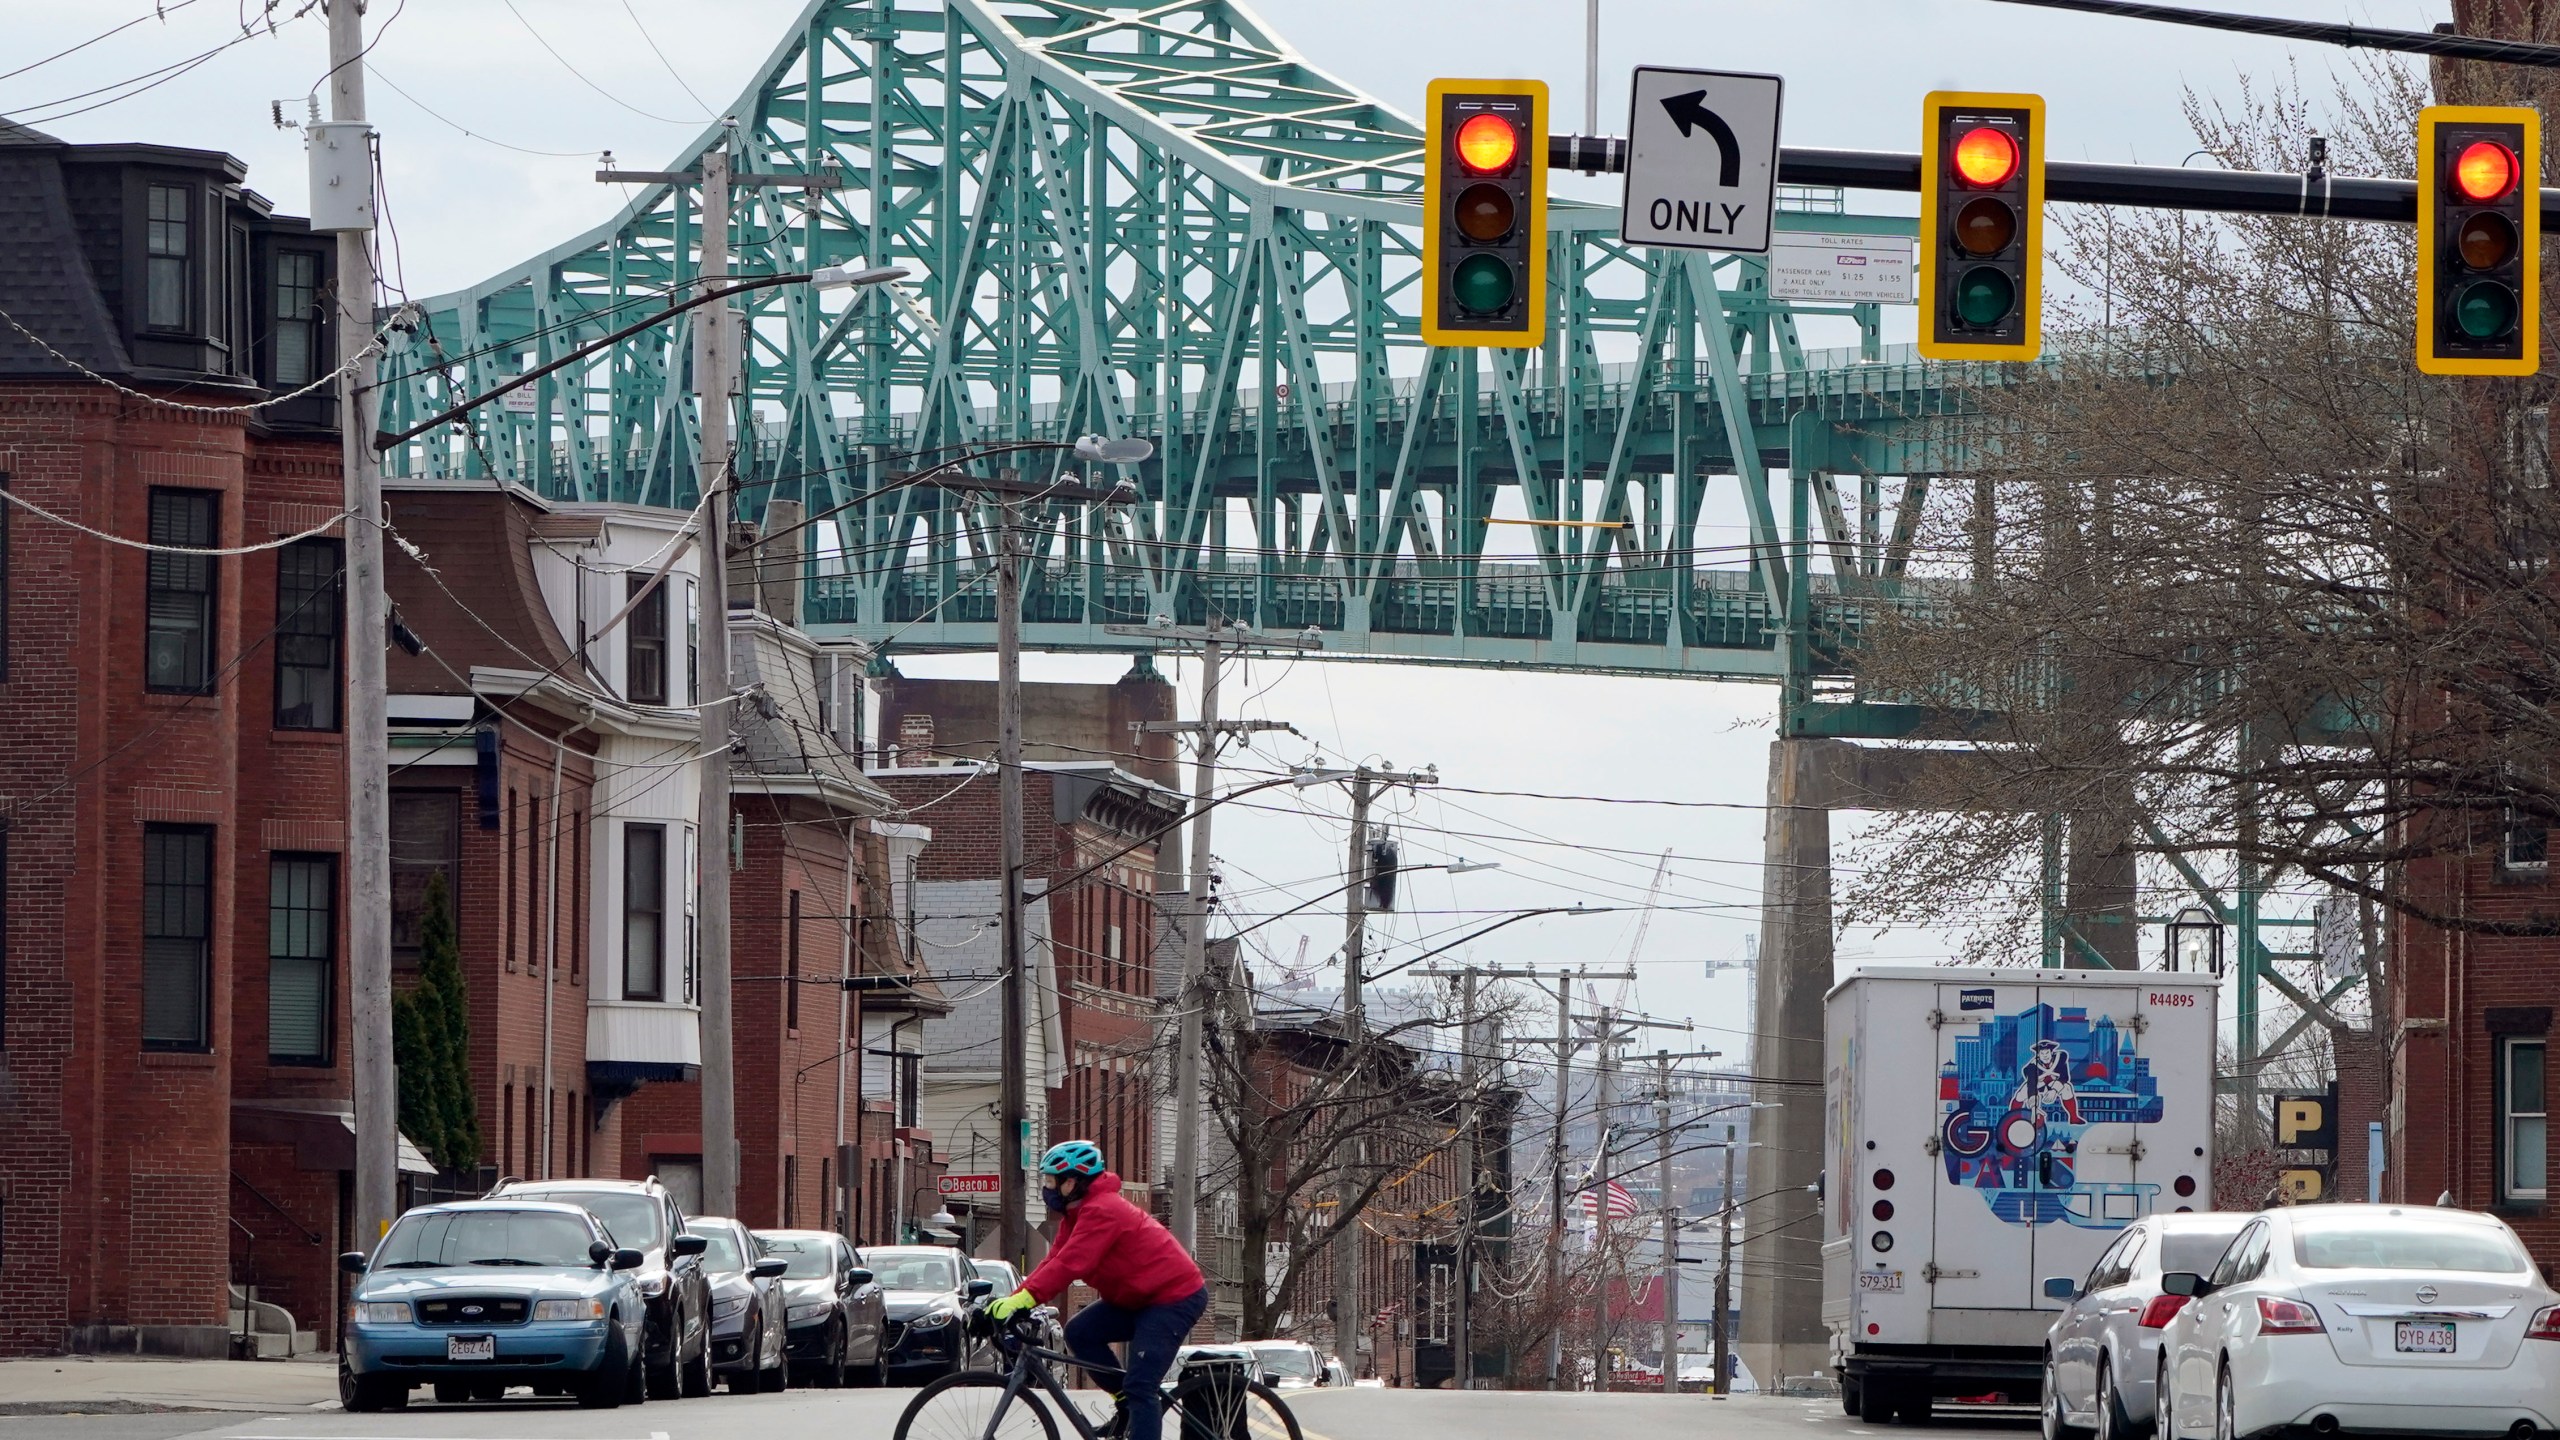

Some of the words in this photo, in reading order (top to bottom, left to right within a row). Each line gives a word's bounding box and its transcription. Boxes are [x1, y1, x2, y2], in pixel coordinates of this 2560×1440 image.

[1650, 198, 1746, 235] ONLY
[1842, 272, 1864, 281] $1.25
[1878, 274, 1901, 282] $1.55
[1961, 995, 1993, 1004] PATRIOTS
[2150, 993, 2194, 1007] R44895
[2279, 1101, 2322, 1144] P
[1943, 1107, 2048, 1158] GO
[953, 1178, 988, 1191] Beacon
[2399, 1330, 2424, 1345] 9YB
[2428, 1331, 2453, 1346] 438
[451, 1342, 476, 1354] 2EGZ
[478, 1342, 491, 1354] 44
